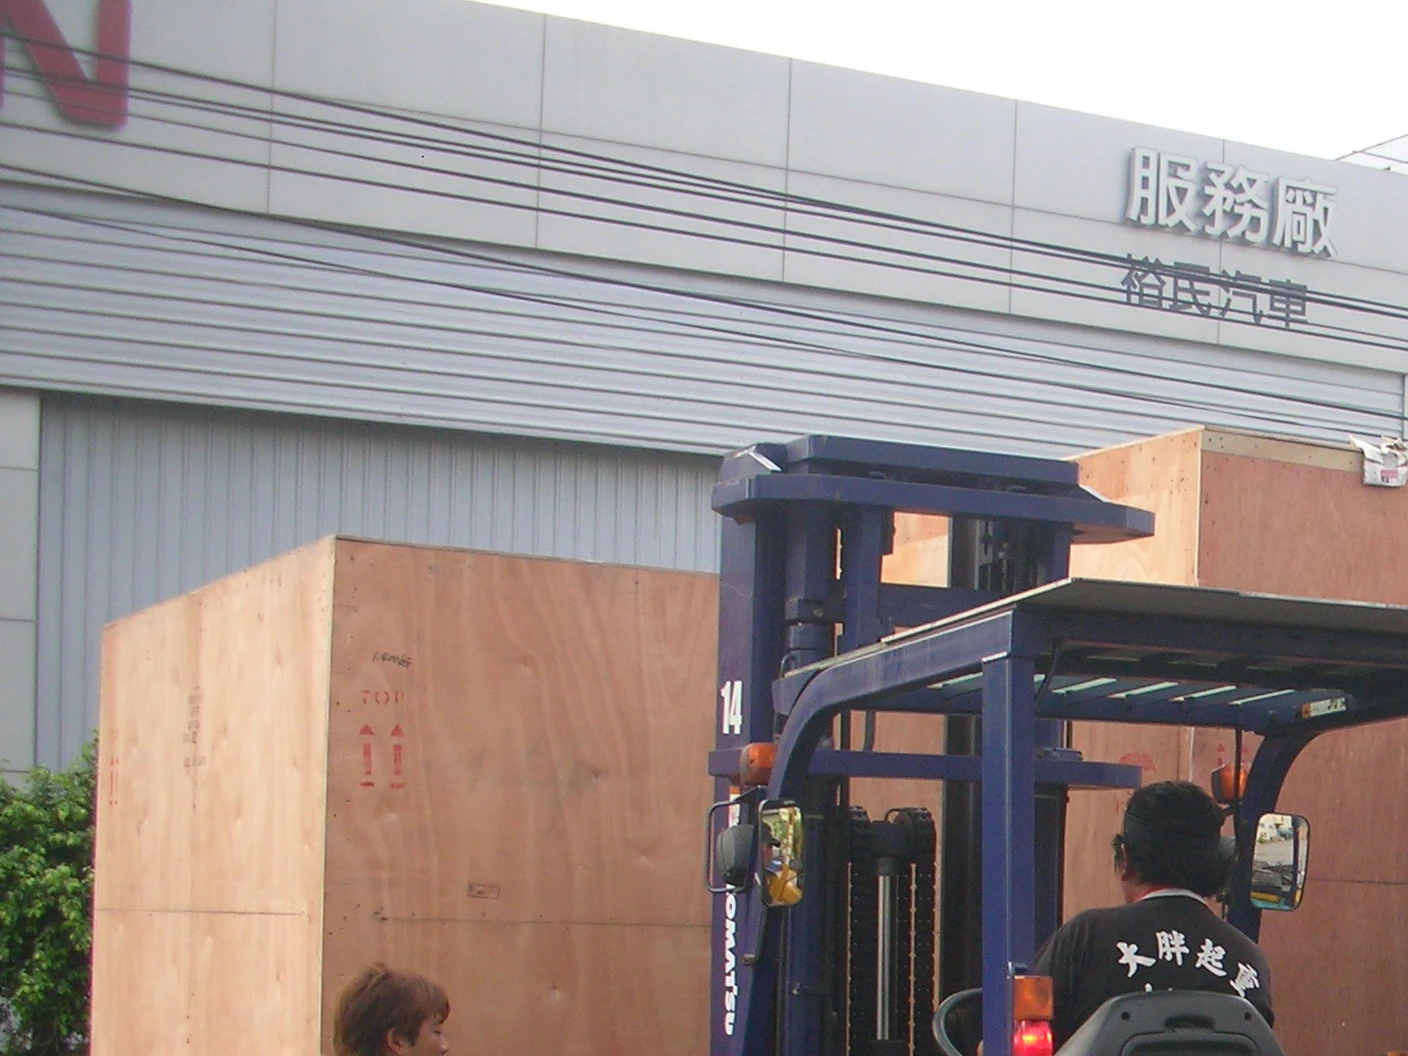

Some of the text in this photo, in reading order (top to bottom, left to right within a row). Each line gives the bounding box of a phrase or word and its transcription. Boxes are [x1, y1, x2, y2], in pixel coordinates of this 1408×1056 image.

[1127, 147, 1338, 257] 服務廠
[1120, 253, 1308, 328] 裕民汽車
[360, 689, 405, 705] TOP
[720, 680, 742, 735] 14
[724, 884, 738, 1036] OMATSU
[1116, 929, 1260, 998] 大胖起重
